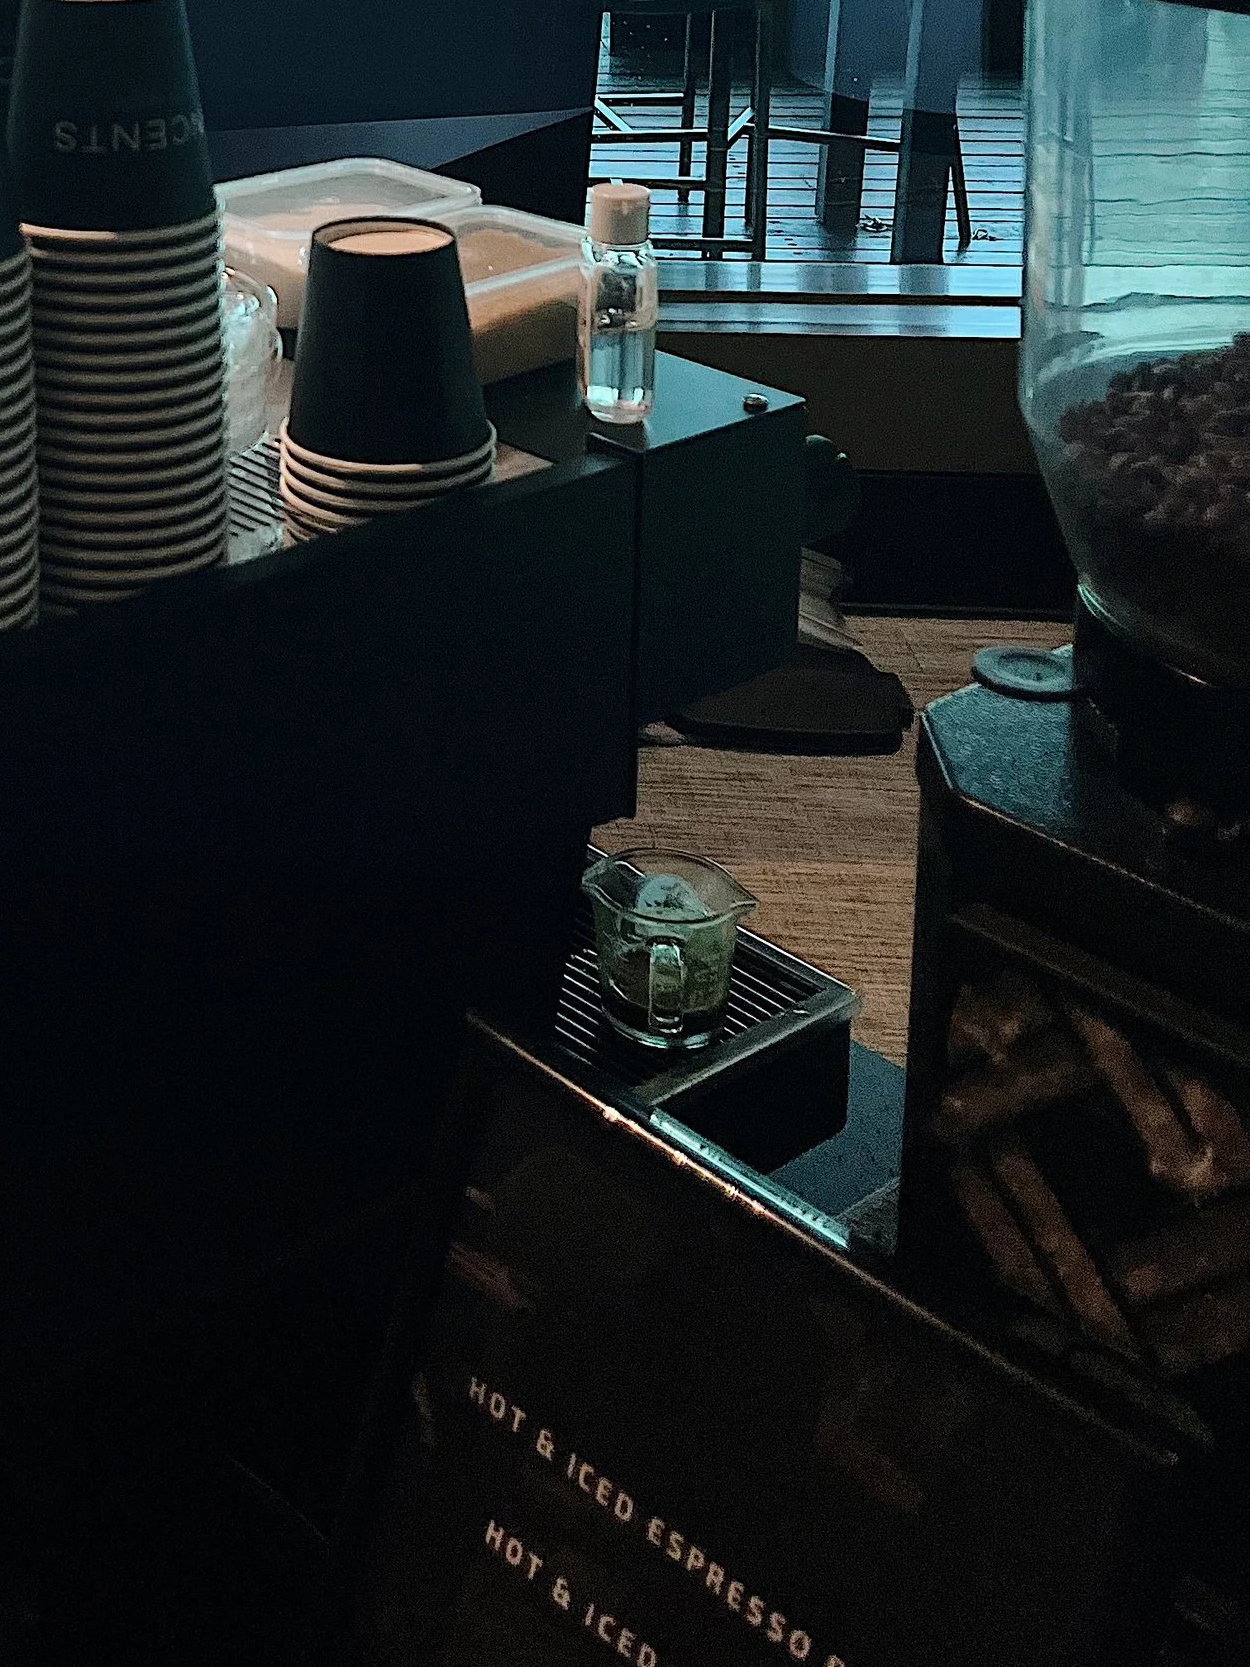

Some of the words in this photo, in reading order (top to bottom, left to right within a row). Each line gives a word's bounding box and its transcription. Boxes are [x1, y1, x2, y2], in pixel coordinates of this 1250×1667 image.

[469, 1376, 526, 1433] HOT
[536, 1428, 554, 1460] &
[566, 1453, 635, 1522] ICED
[647, 1516, 812, 1660] ESPRESSO
[485, 1519, 543, 1581] HOT
[552, 1577, 571, 1611] &
[584, 1603, 657, 1667] ICED
